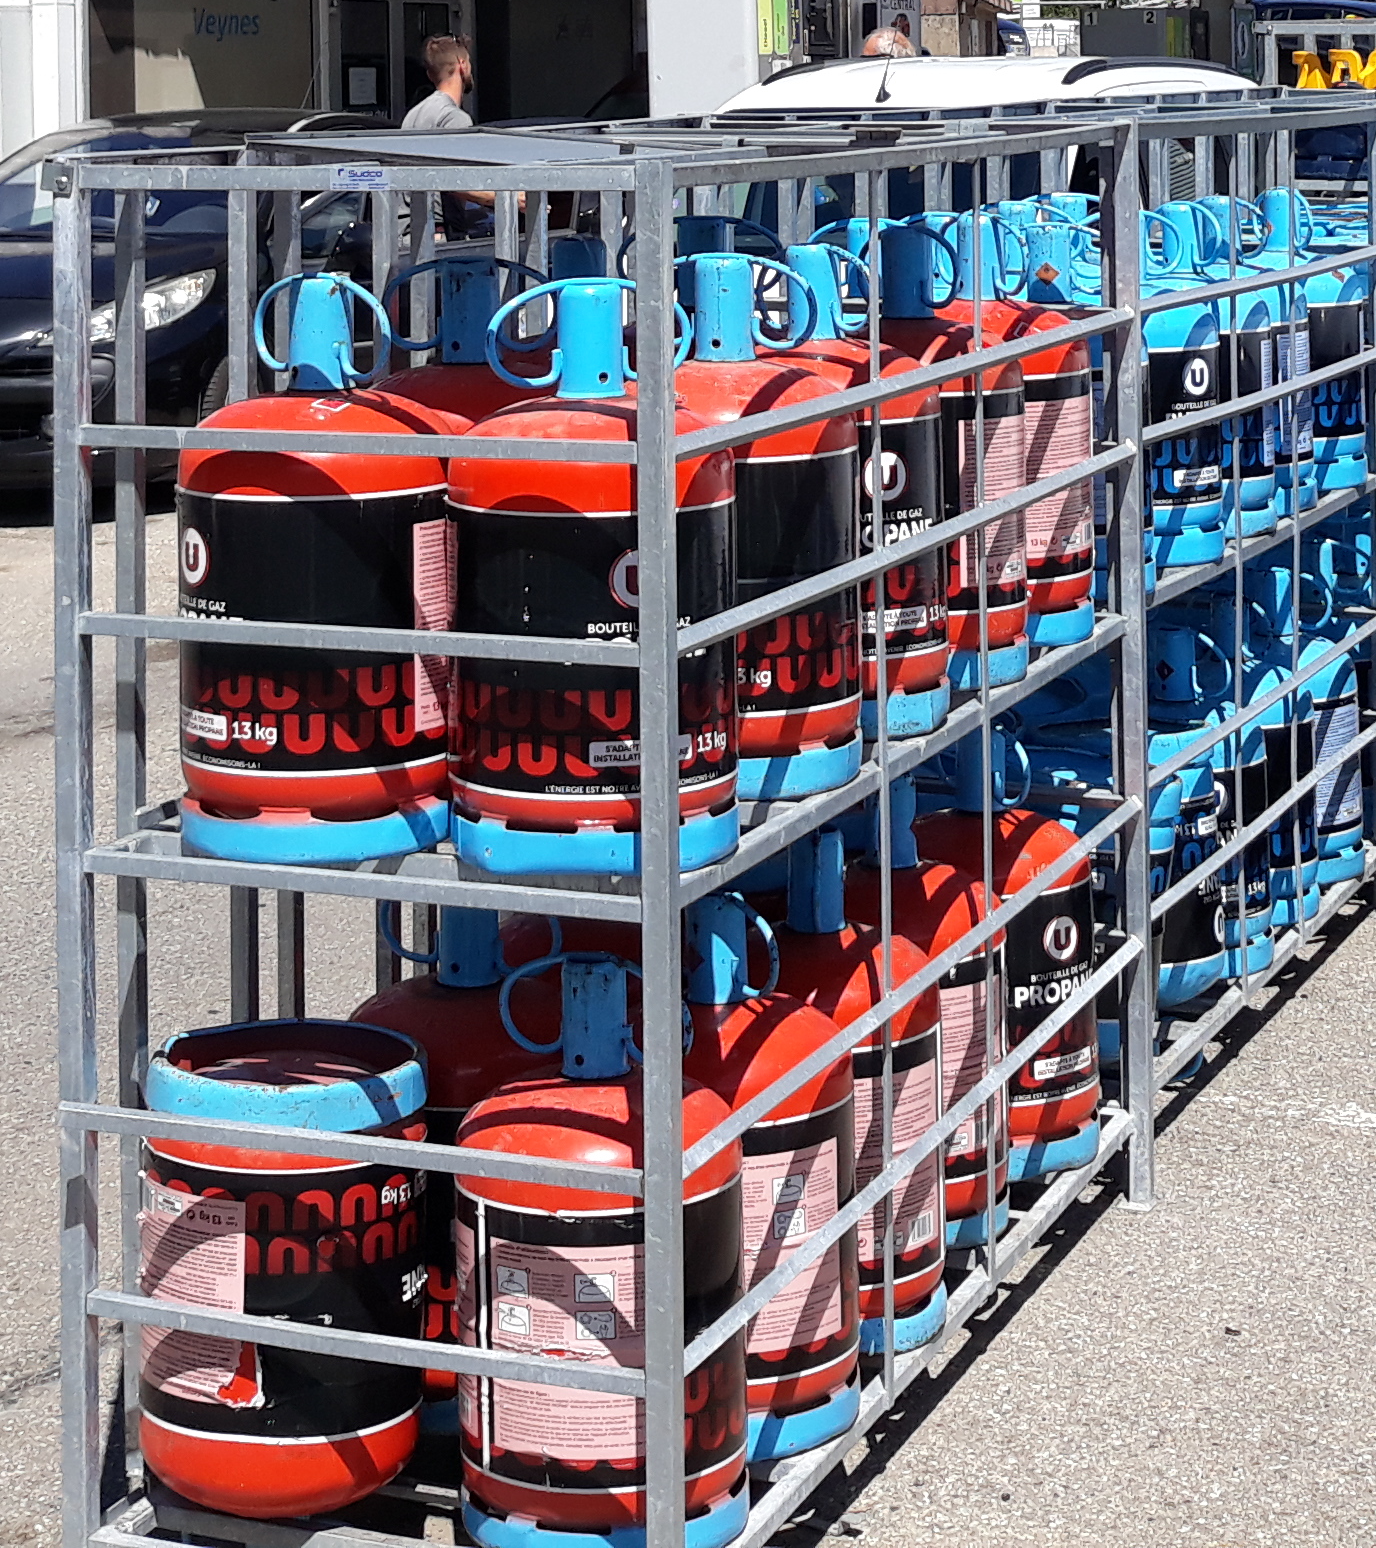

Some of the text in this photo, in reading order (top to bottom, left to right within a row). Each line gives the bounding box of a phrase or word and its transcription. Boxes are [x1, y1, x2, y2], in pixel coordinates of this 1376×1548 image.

[193, 7, 260, 42] Veynes
[1086, 12, 1093, 25] 1
[1145, 11, 1155, 24] 2
[208, 599, 227, 613] GAZ
[750, 667, 772, 688] kg
[231, 719, 278, 744] 13 kg
[696, 730, 727, 752] 13 kg
[585, 784, 601, 794] EST
[1053, 925, 1072, 951] U
[1030, 967, 1070, 983] BOUTEILLE
[381, 1181, 412, 1206] kg 13
